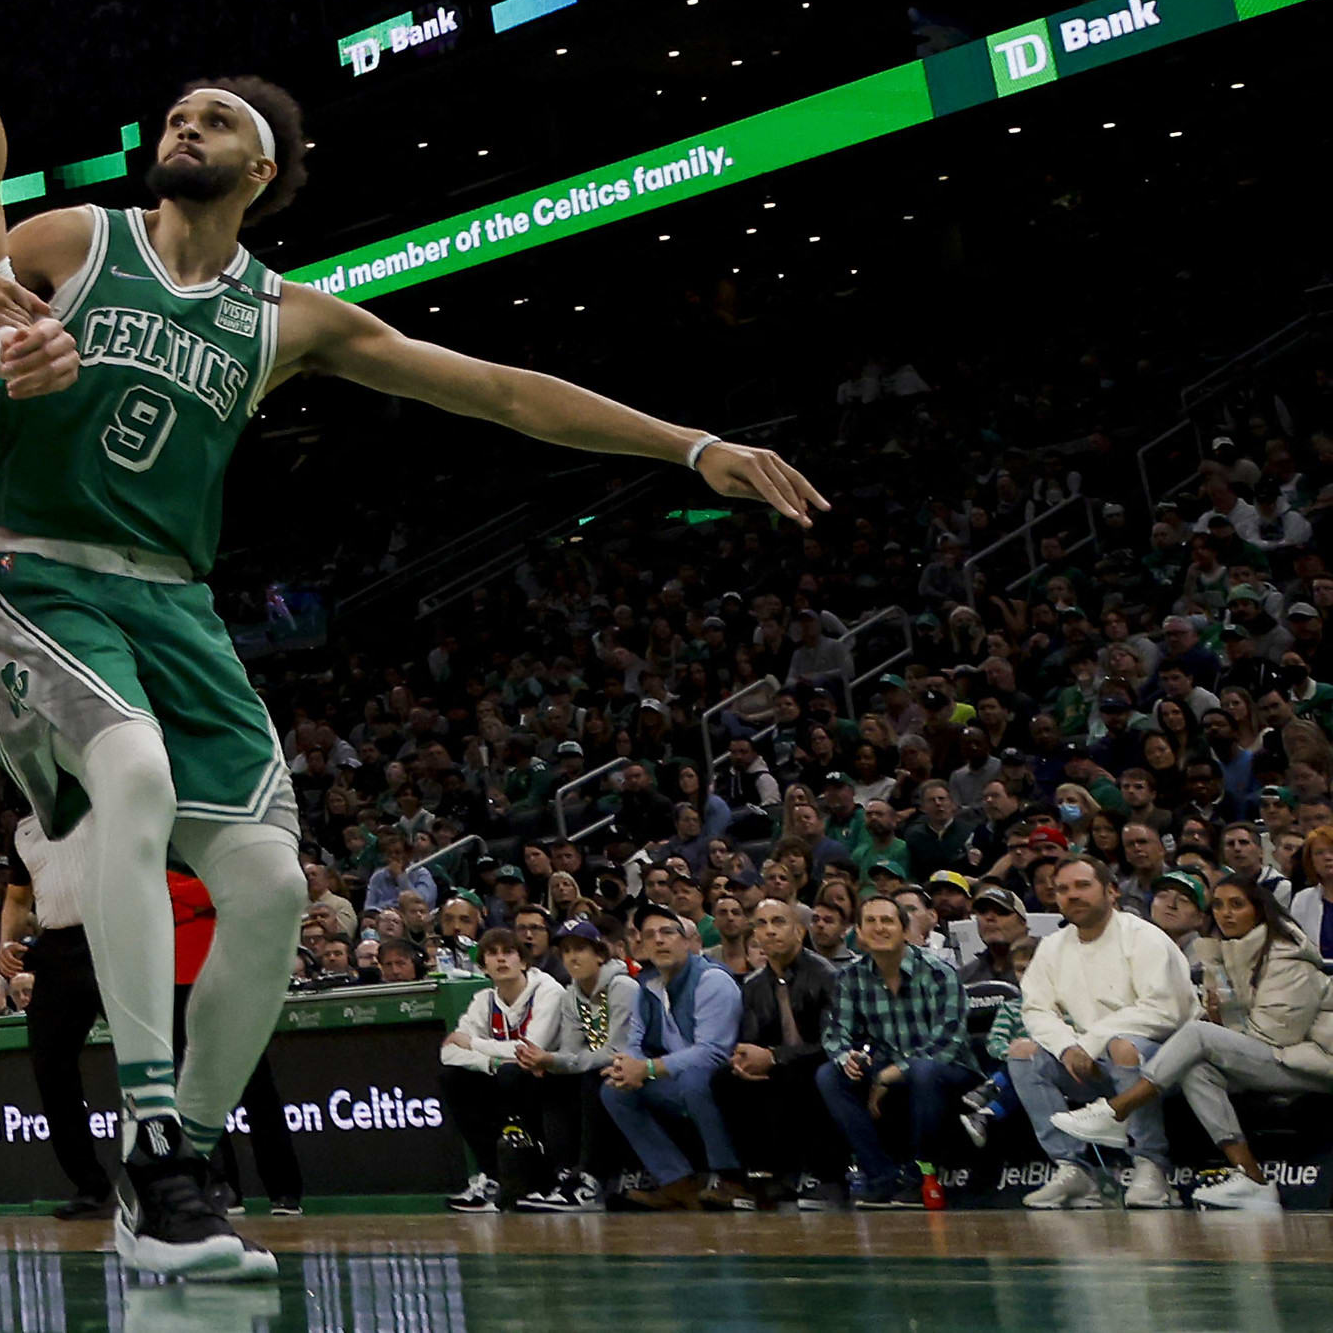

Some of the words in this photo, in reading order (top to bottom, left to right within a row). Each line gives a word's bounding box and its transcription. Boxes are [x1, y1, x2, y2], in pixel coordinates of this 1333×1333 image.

[343, 37, 380, 77] TD
[390, 7, 458, 53] Bank
[994, 34, 1047, 80] TD
[347, 235, 450, 288] member
[455, 219, 482, 252] of
[485, 212, 529, 245] the
[533, 182, 631, 227] Celtics
[632, 145, 734, 195] family.
[223, 302, 252, 323] VISTA
[79, 306, 248, 422] CELTICS
[100, 385, 177, 472] 9
[4, 1104, 117, 1142] Proer
[329, 1086, 443, 1130] Celtics
